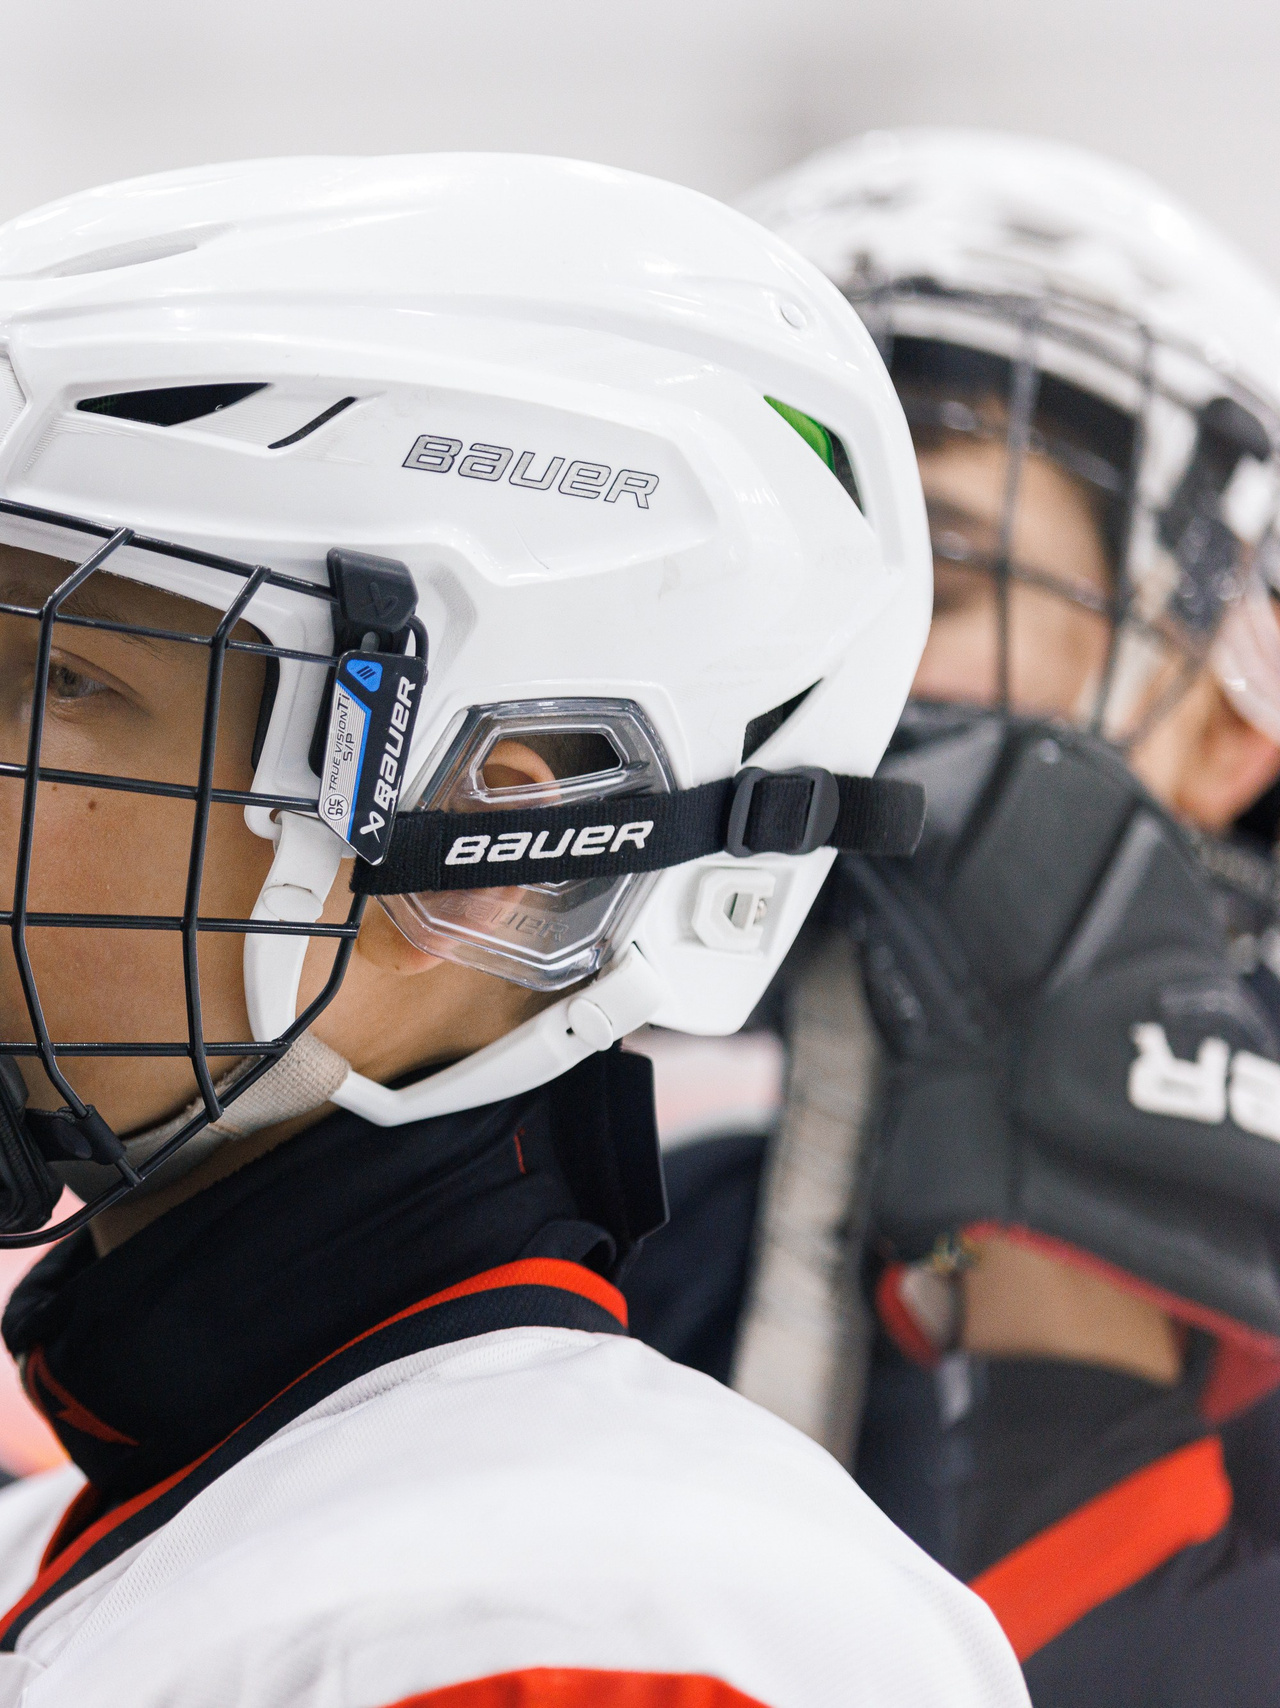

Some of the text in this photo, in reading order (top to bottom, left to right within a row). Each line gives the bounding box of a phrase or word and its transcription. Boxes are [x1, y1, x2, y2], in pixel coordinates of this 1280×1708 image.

[401, 434, 660, 509] BAUER
[343, 732, 356, 762] S/P
[374, 676, 416, 811] BAUER
[329, 757, 341, 791] TRUE
[444, 820, 654, 866] BAUER
